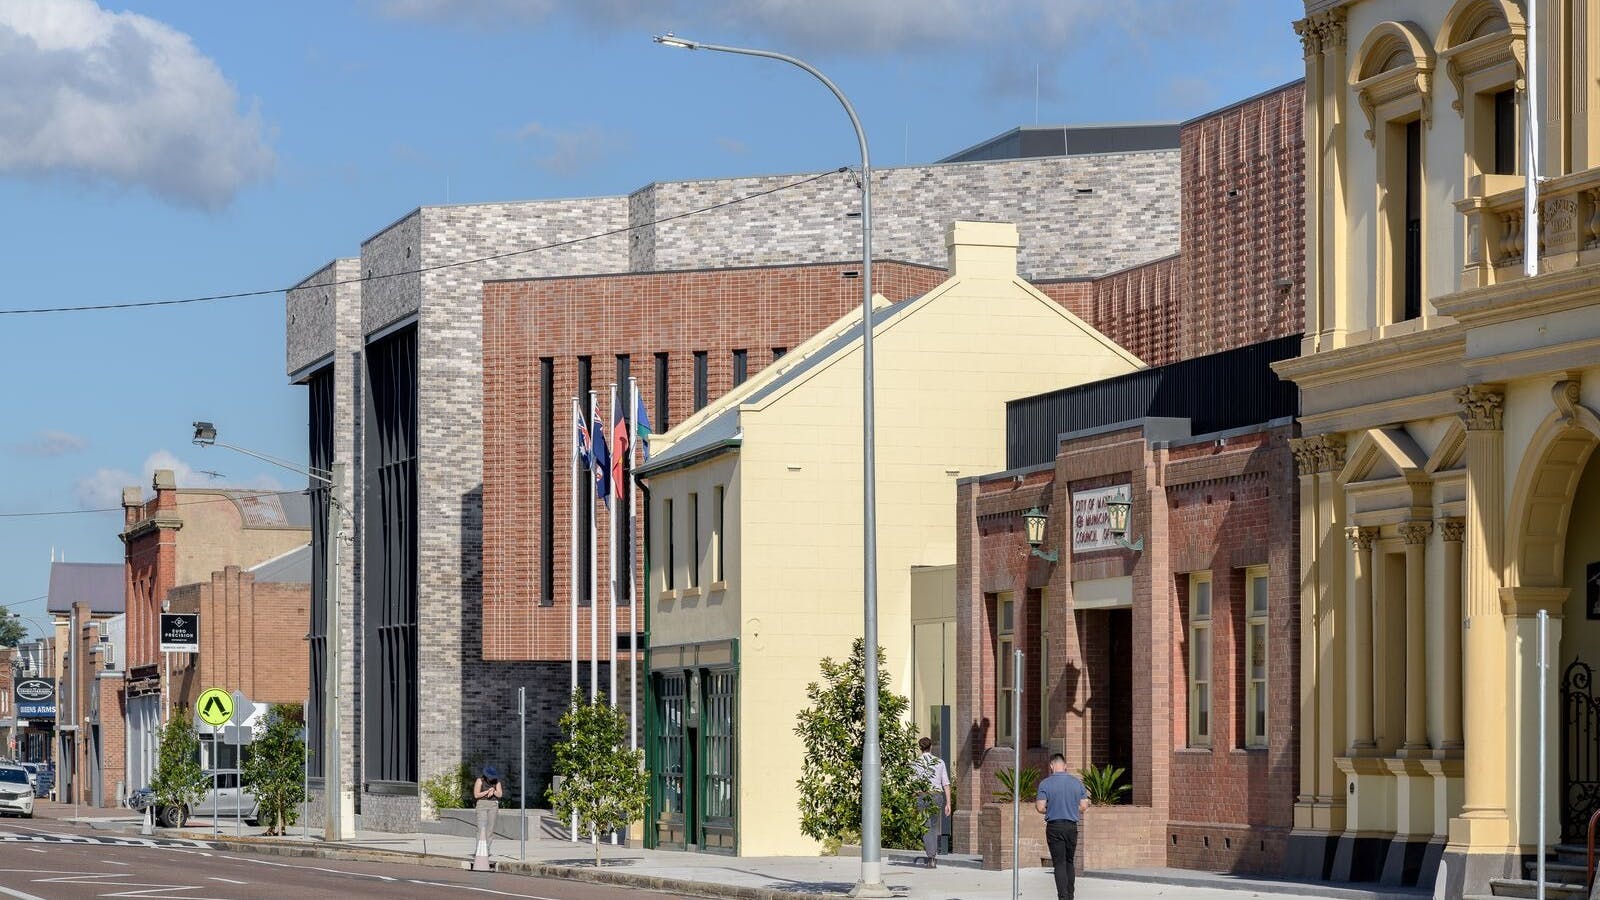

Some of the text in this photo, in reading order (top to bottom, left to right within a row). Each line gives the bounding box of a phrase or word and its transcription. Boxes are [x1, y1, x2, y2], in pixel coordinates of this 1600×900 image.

[1075, 499, 1087, 512] CITY
[1088, 498, 1095, 510] OF
[1085, 512, 1111, 526] MUNICIP
[1075, 530, 1098, 544] COUNCIL
